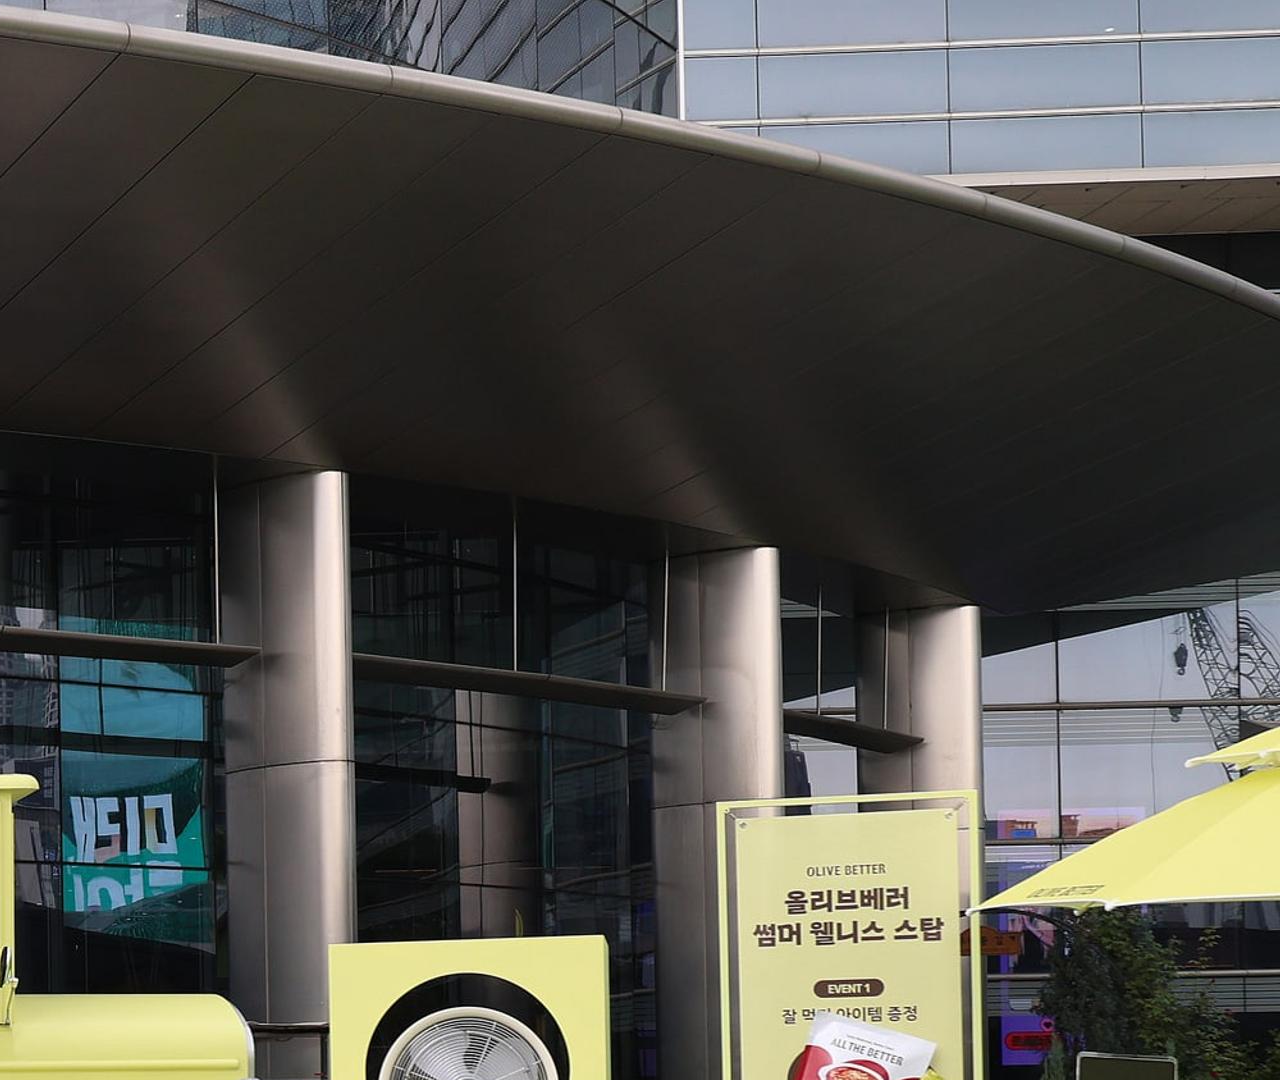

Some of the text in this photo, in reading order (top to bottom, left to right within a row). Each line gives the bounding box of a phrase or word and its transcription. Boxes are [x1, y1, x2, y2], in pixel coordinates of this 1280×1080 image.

[807, 863, 886, 877] OLIVE BETTER
[784, 887, 909, 914] 올리브베러
[753, 923, 802, 947] 썸머
[810, 921, 885, 945] 웰니스
[893, 917, 944, 942] 스탑
[828, 983, 871, 994] EVENT 1
[782, 1009, 797, 1024] 잘
[836, 1007, 882, 1022] 아이템
[887, 1006, 918, 1021] 증정
[830, 1038, 847, 1050] ALL
[848, 1042, 866, 1055] THE
[867, 1047, 904, 1066] BETTER
